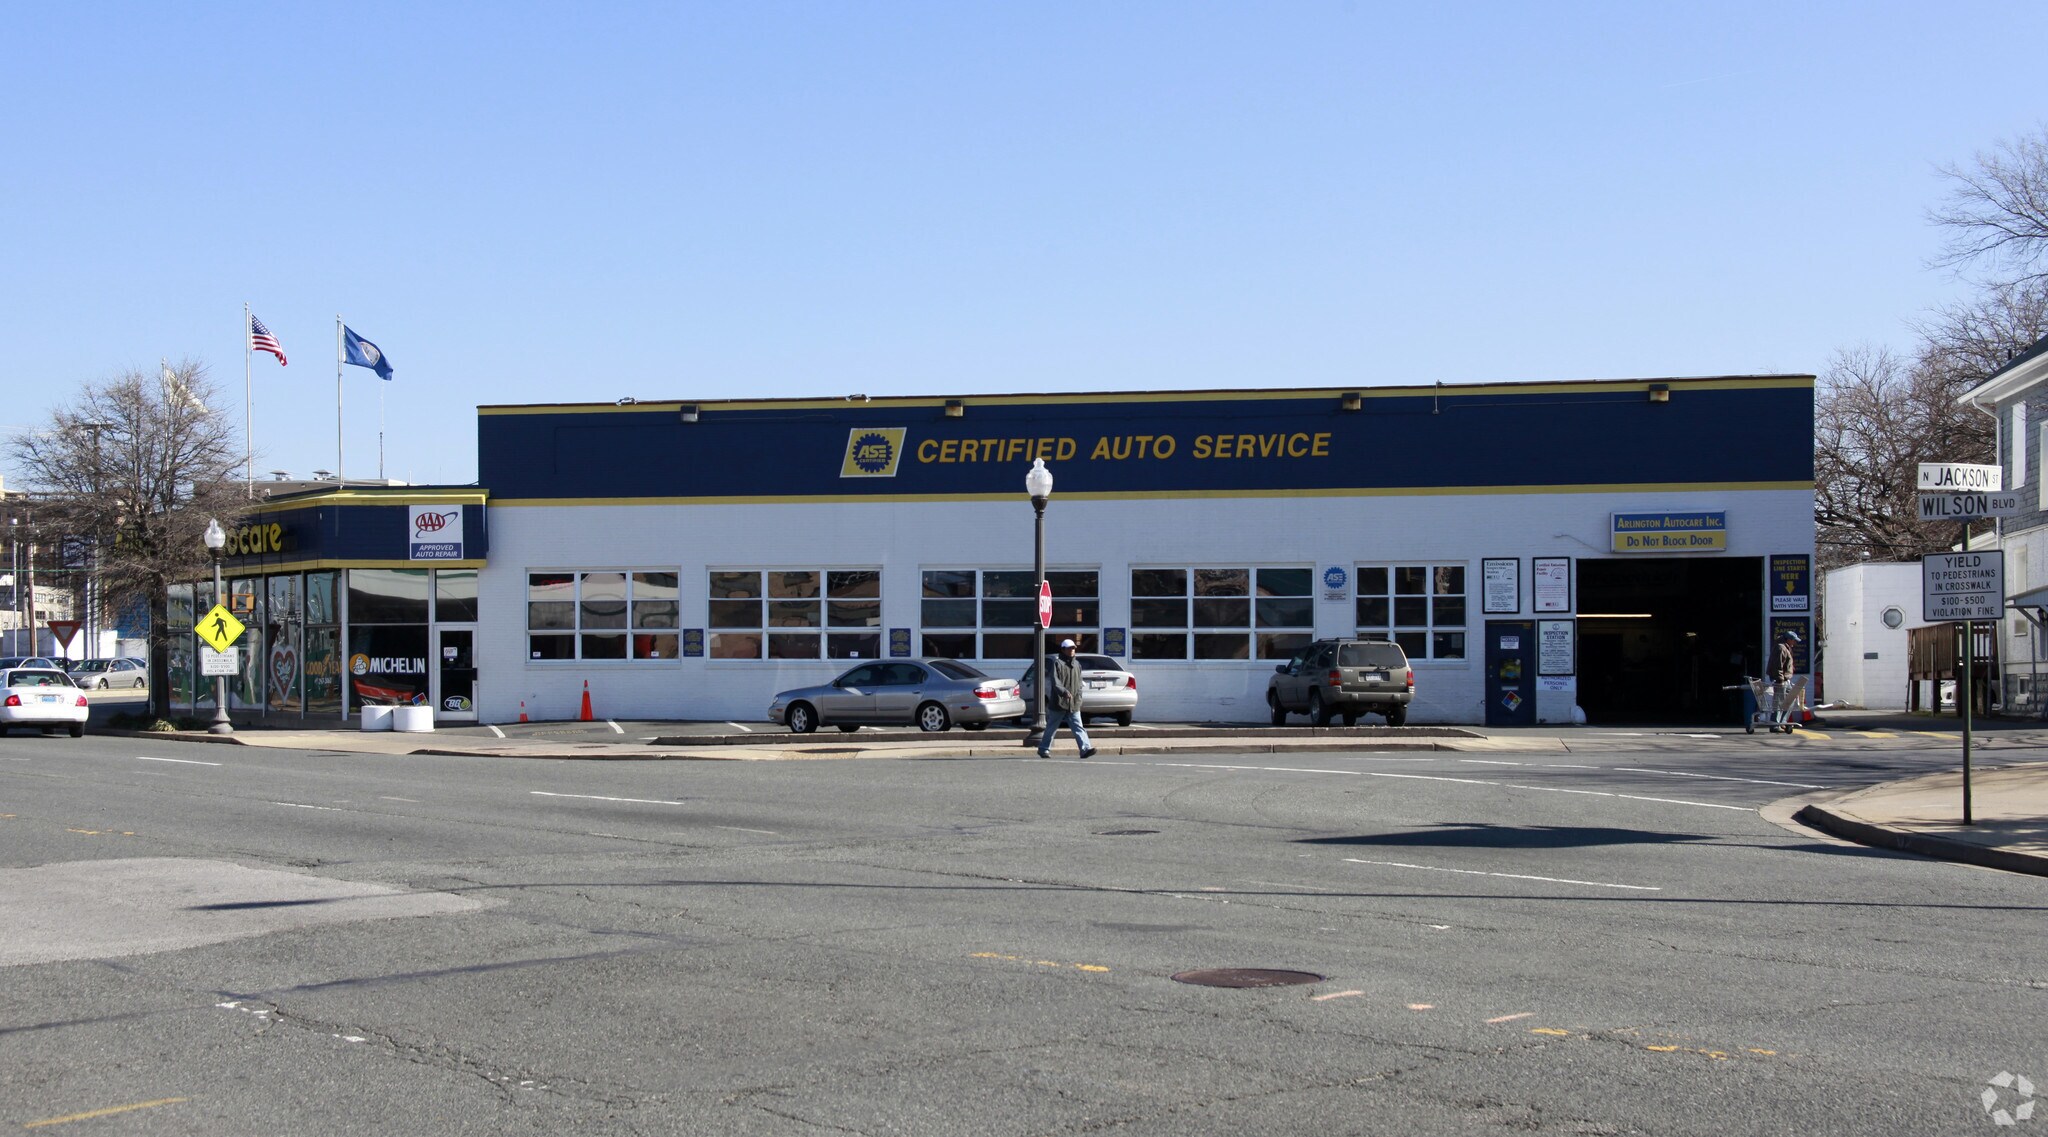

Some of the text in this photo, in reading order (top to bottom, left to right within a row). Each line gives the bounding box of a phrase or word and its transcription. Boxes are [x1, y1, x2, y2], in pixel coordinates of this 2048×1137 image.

[857, 445, 887, 459] ASE
[917, 432, 1332, 463] CERTIFIED AUTO SERVICE
[1923, 467, 1999, 488] N JACKSON ST
[1922, 495, 2015, 516] WILSON BLVD
[417, 512, 444, 532] AAA
[1617, 517, 1661, 529] ARLINGTON
[1663, 516, 1703, 528] AUTOCARE
[225, 523, 282, 556] ocare
[1662, 535, 1687, 546] BLOCK
[1690, 534, 1713, 546] DOOR
[1945, 555, 1981, 568] YIELD
[1327, 573, 1344, 581] ASE
[1780, 572, 1800, 580] HERE
[1931, 568, 1996, 580] TO PEDESTRIANS
[1935, 580, 1991, 591] IN CROSSWALK
[1040, 595, 1051, 613] STOP
[1941, 595, 1985, 606] $100-$500
[1932, 606, 1995, 617] VIOLATION FINE
[369, 657, 426, 674] MICHELIN
[448, 698, 461, 708] BG
